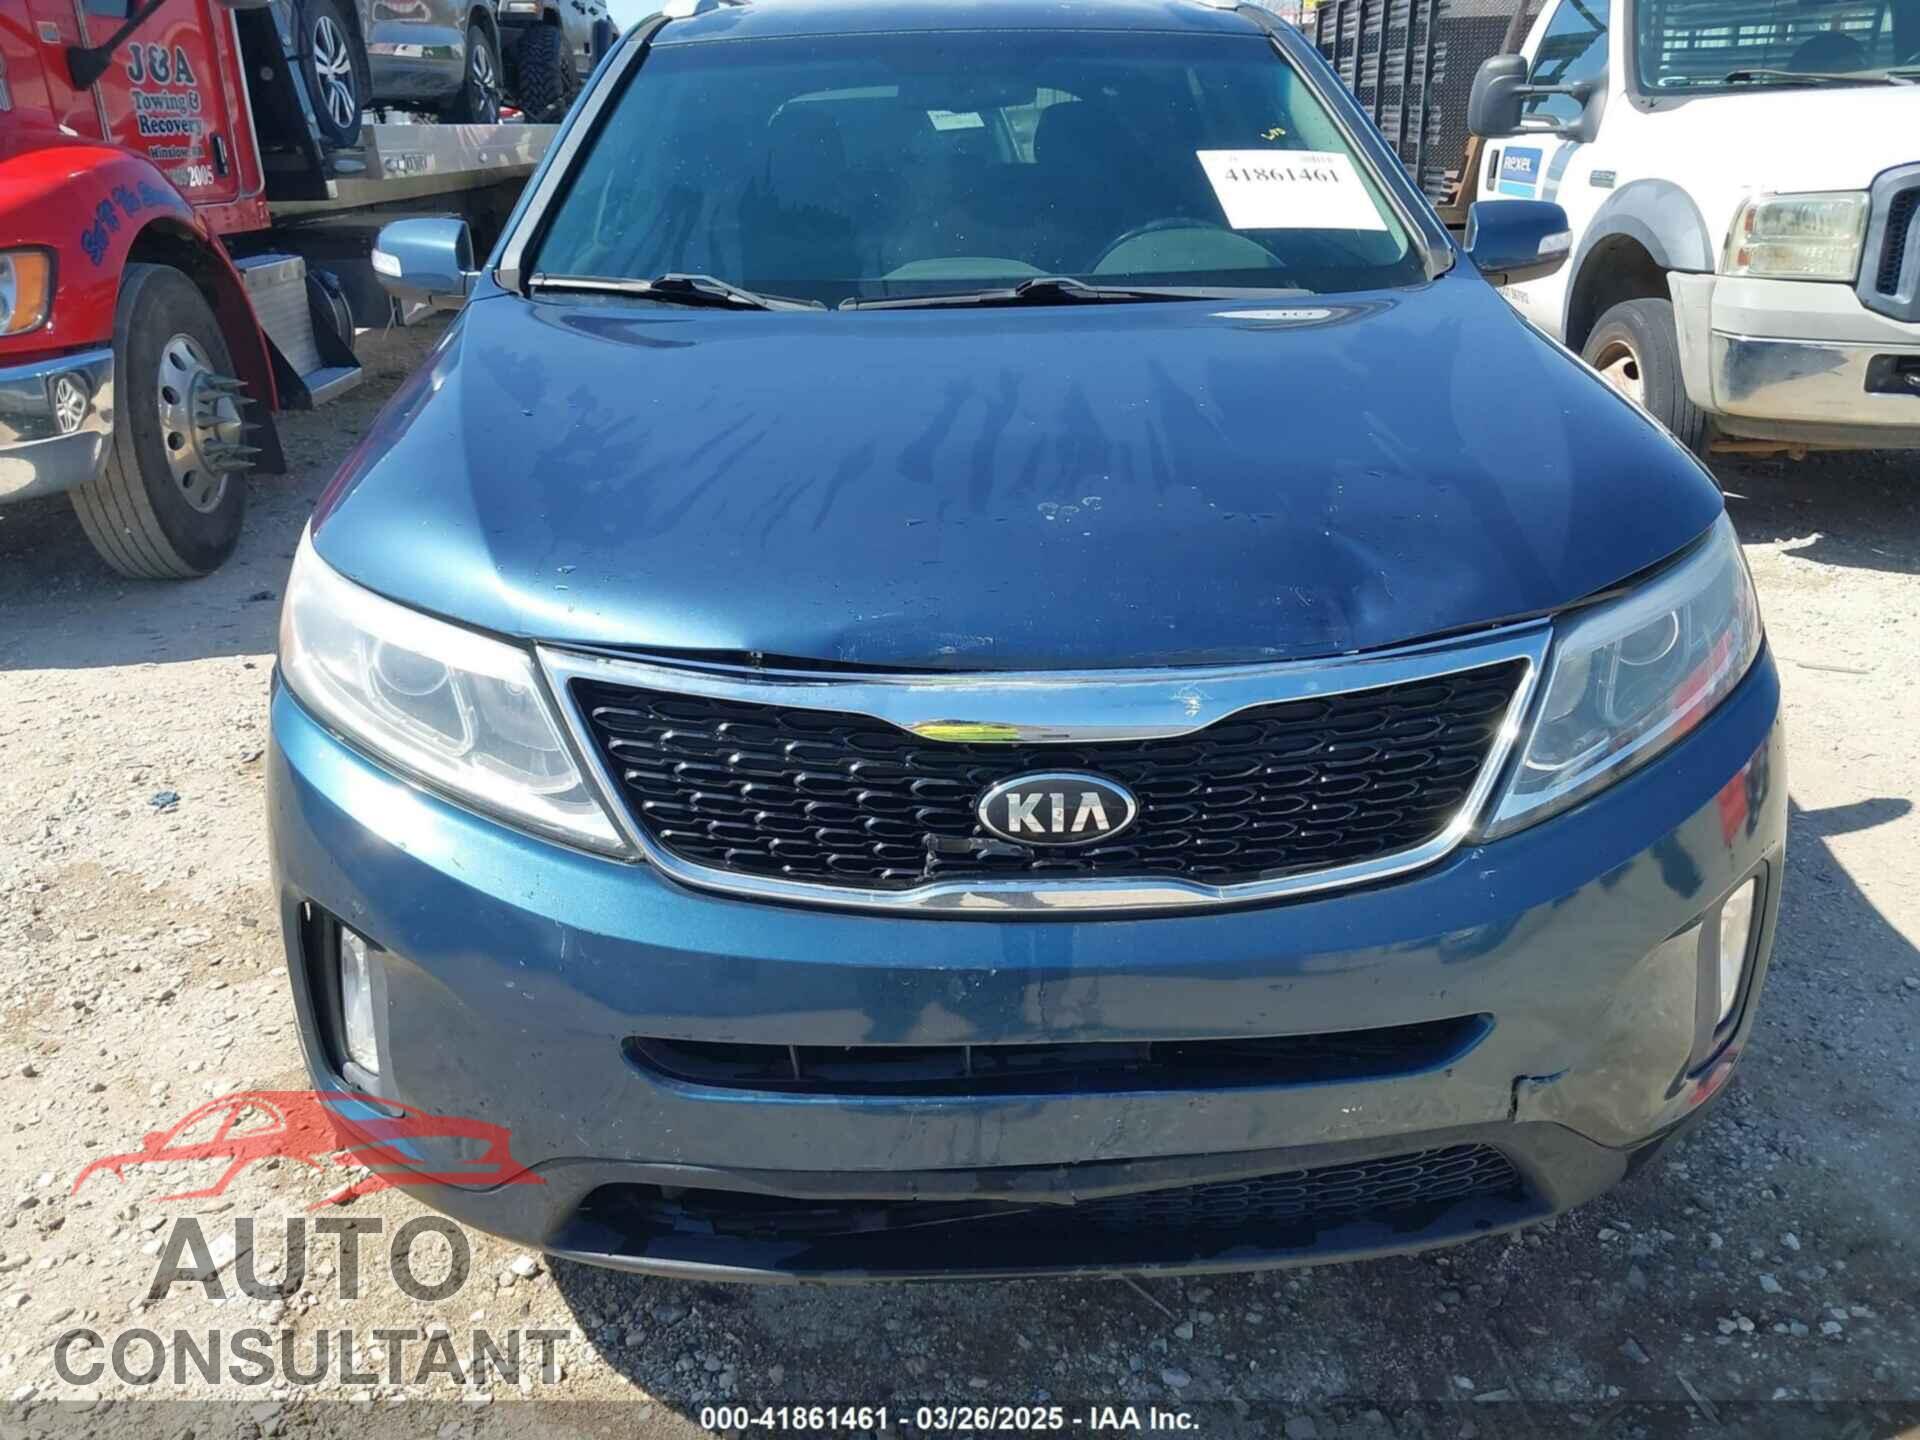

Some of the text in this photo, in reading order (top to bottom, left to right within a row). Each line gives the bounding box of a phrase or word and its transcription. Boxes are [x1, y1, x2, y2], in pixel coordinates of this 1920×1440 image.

[127, 42, 197, 85] J&A
[129, 88, 187, 114] Towing
[1224, 167, 1340, 183] 41861461
[1006, 792, 1110, 832] KIA
